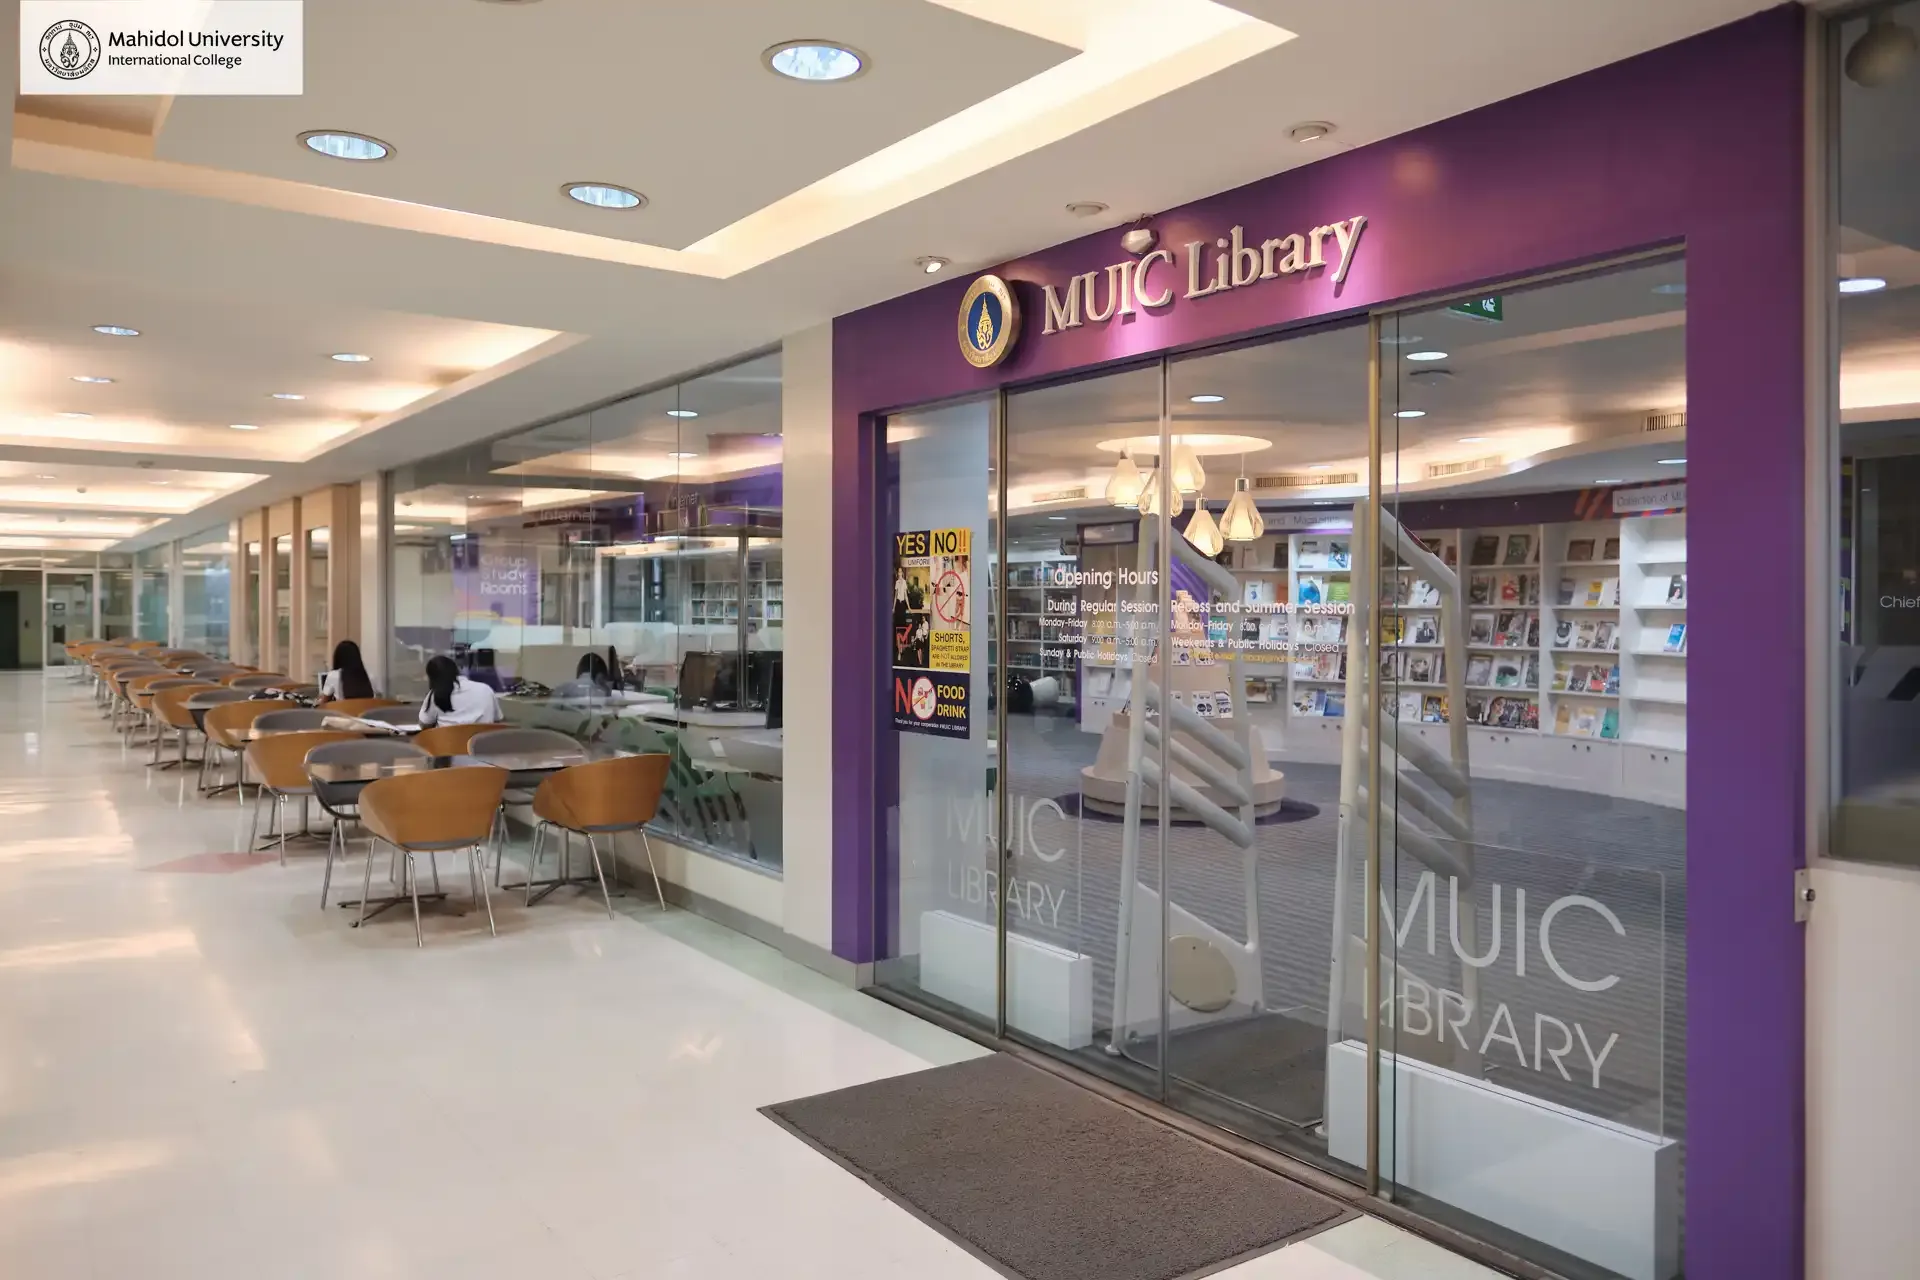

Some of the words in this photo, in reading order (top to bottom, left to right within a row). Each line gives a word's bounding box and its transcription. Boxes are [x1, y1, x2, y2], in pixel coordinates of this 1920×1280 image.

[1041, 249, 1174, 335] MUIC
[1183, 215, 1368, 300] Library
[896, 533, 925, 555] YES
[1054, 568, 1112, 589] Opening
[1118, 568, 1158, 585] Hours
[1048, 600, 1077, 614] During
[1081, 600, 1117, 614] Regular
[1121, 600, 1158, 613] Session
[1170, 600, 1211, 613] Recess
[1216, 600, 1240, 613] and
[1245, 601, 1297, 614] Summer
[1303, 600, 1356, 615] Session
[1880, 595, 1920, 608] Chief
[1039, 618, 1088, 628] Monday-Friday
[1170, 620, 1234, 632] Monday-Friday
[934, 632, 965, 644] SHORTS,
[1058, 633, 1088, 645] Saturday
[1171, 637, 1215, 648] Weekends
[1218, 639, 1225, 648] &
[1228, 638, 1256, 649] Public
[1259, 640, 1299, 651] Holidays
[1304, 642, 1340, 653] Closed
[1039, 648, 1064, 658] Sunday
[1066, 650, 1072, 658] &
[1073, 650, 1095, 659] Public
[1097, 651, 1128, 662] Holidays
[937, 684, 965, 700] FOOD
[937, 703, 966, 719] DRINK
[947, 790, 1066, 862] MUIC
[948, 860, 1066, 928] LIBRARY
[1364, 859, 1626, 992] MUIC
[1363, 966, 1619, 1089] LIBRARY
